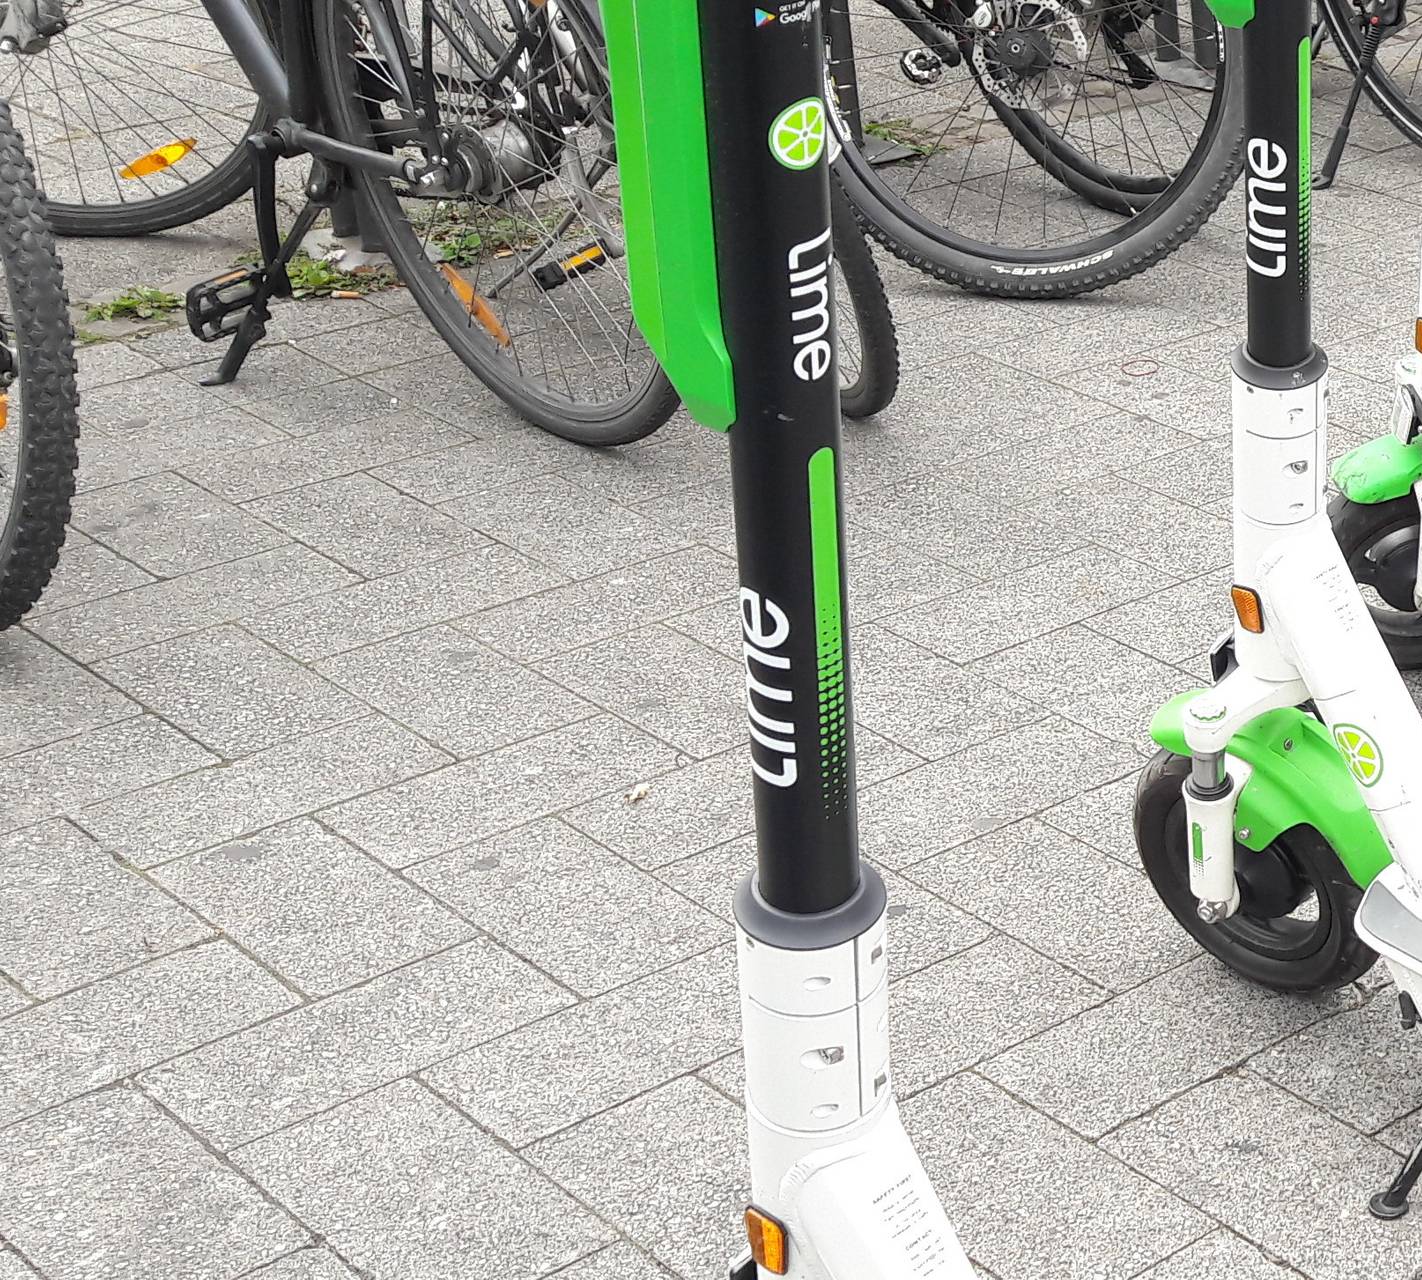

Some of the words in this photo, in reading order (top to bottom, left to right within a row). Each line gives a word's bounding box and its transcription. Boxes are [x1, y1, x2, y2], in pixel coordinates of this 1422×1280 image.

[1246, 137, 1288, 278] Lime
[788, 228, 833, 381] Lime
[739, 586, 798, 788] Lime
